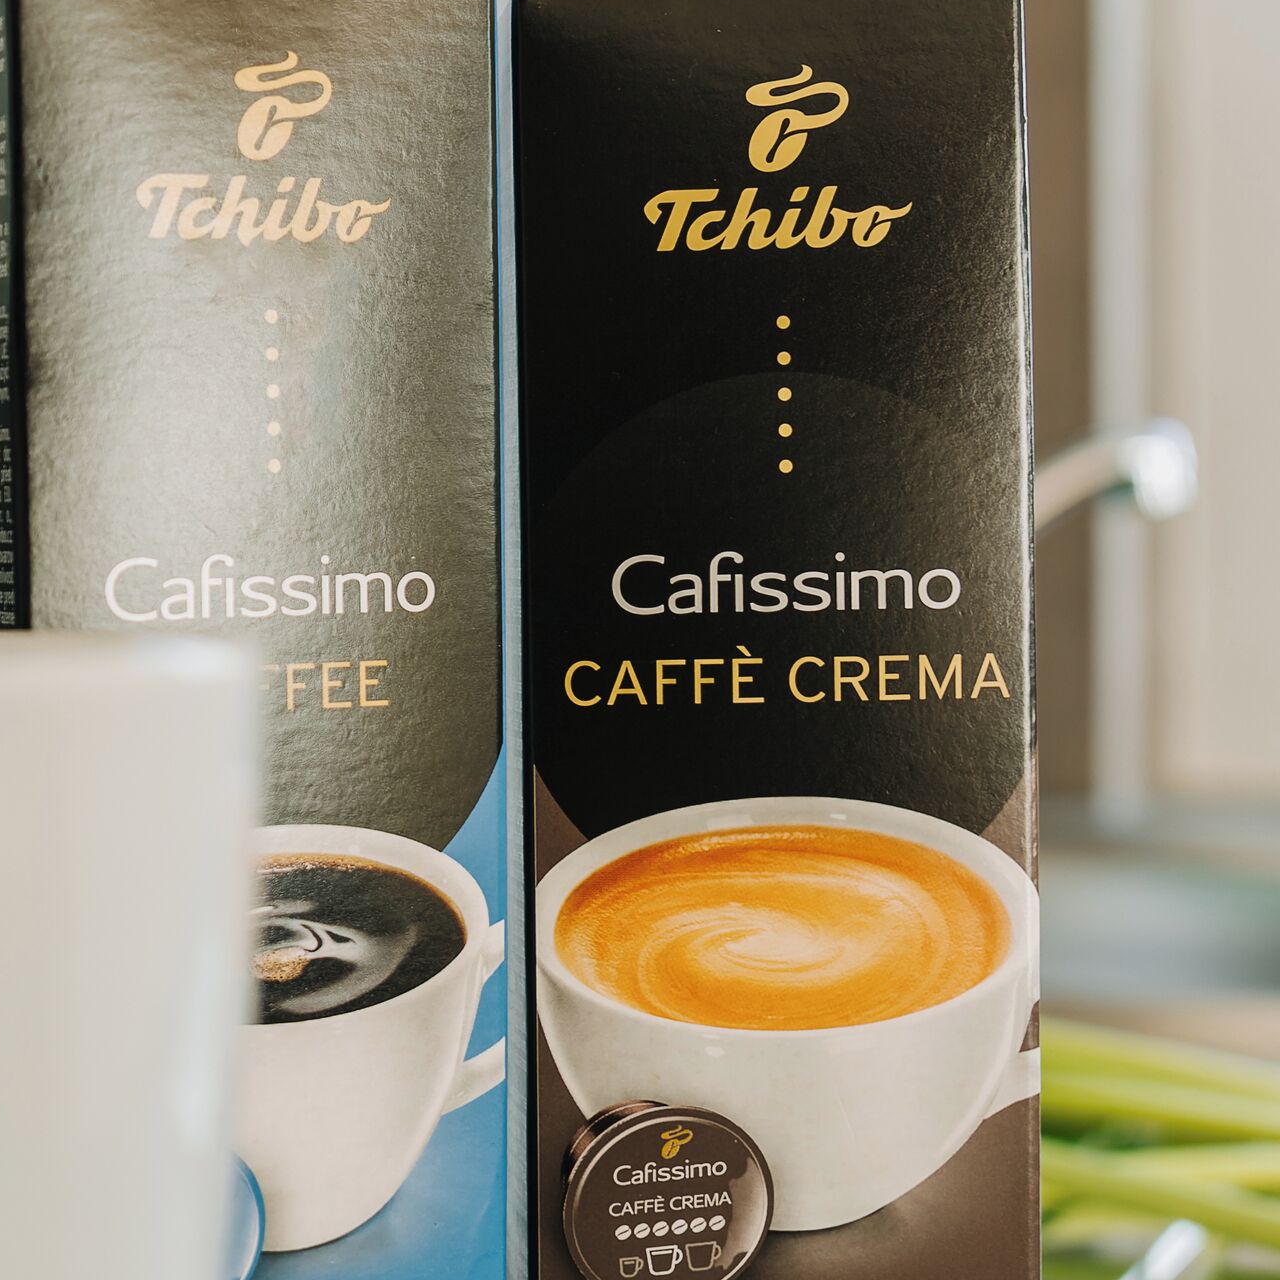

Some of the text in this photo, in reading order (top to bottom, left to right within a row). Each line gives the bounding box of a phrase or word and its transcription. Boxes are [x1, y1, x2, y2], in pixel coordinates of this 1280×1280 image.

[137, 173, 391, 244] Tchibo
[644, 184, 912, 252] Tchibo
[105, 555, 436, 622] Cafissimo
[612, 551, 961, 615] Cafissimo
[565, 646, 1009, 706] CAFFÈ CREMA
[608, 1191, 732, 1217] CAFFÈ CREMA
[613, 1160, 727, 1186] Cafissimo
